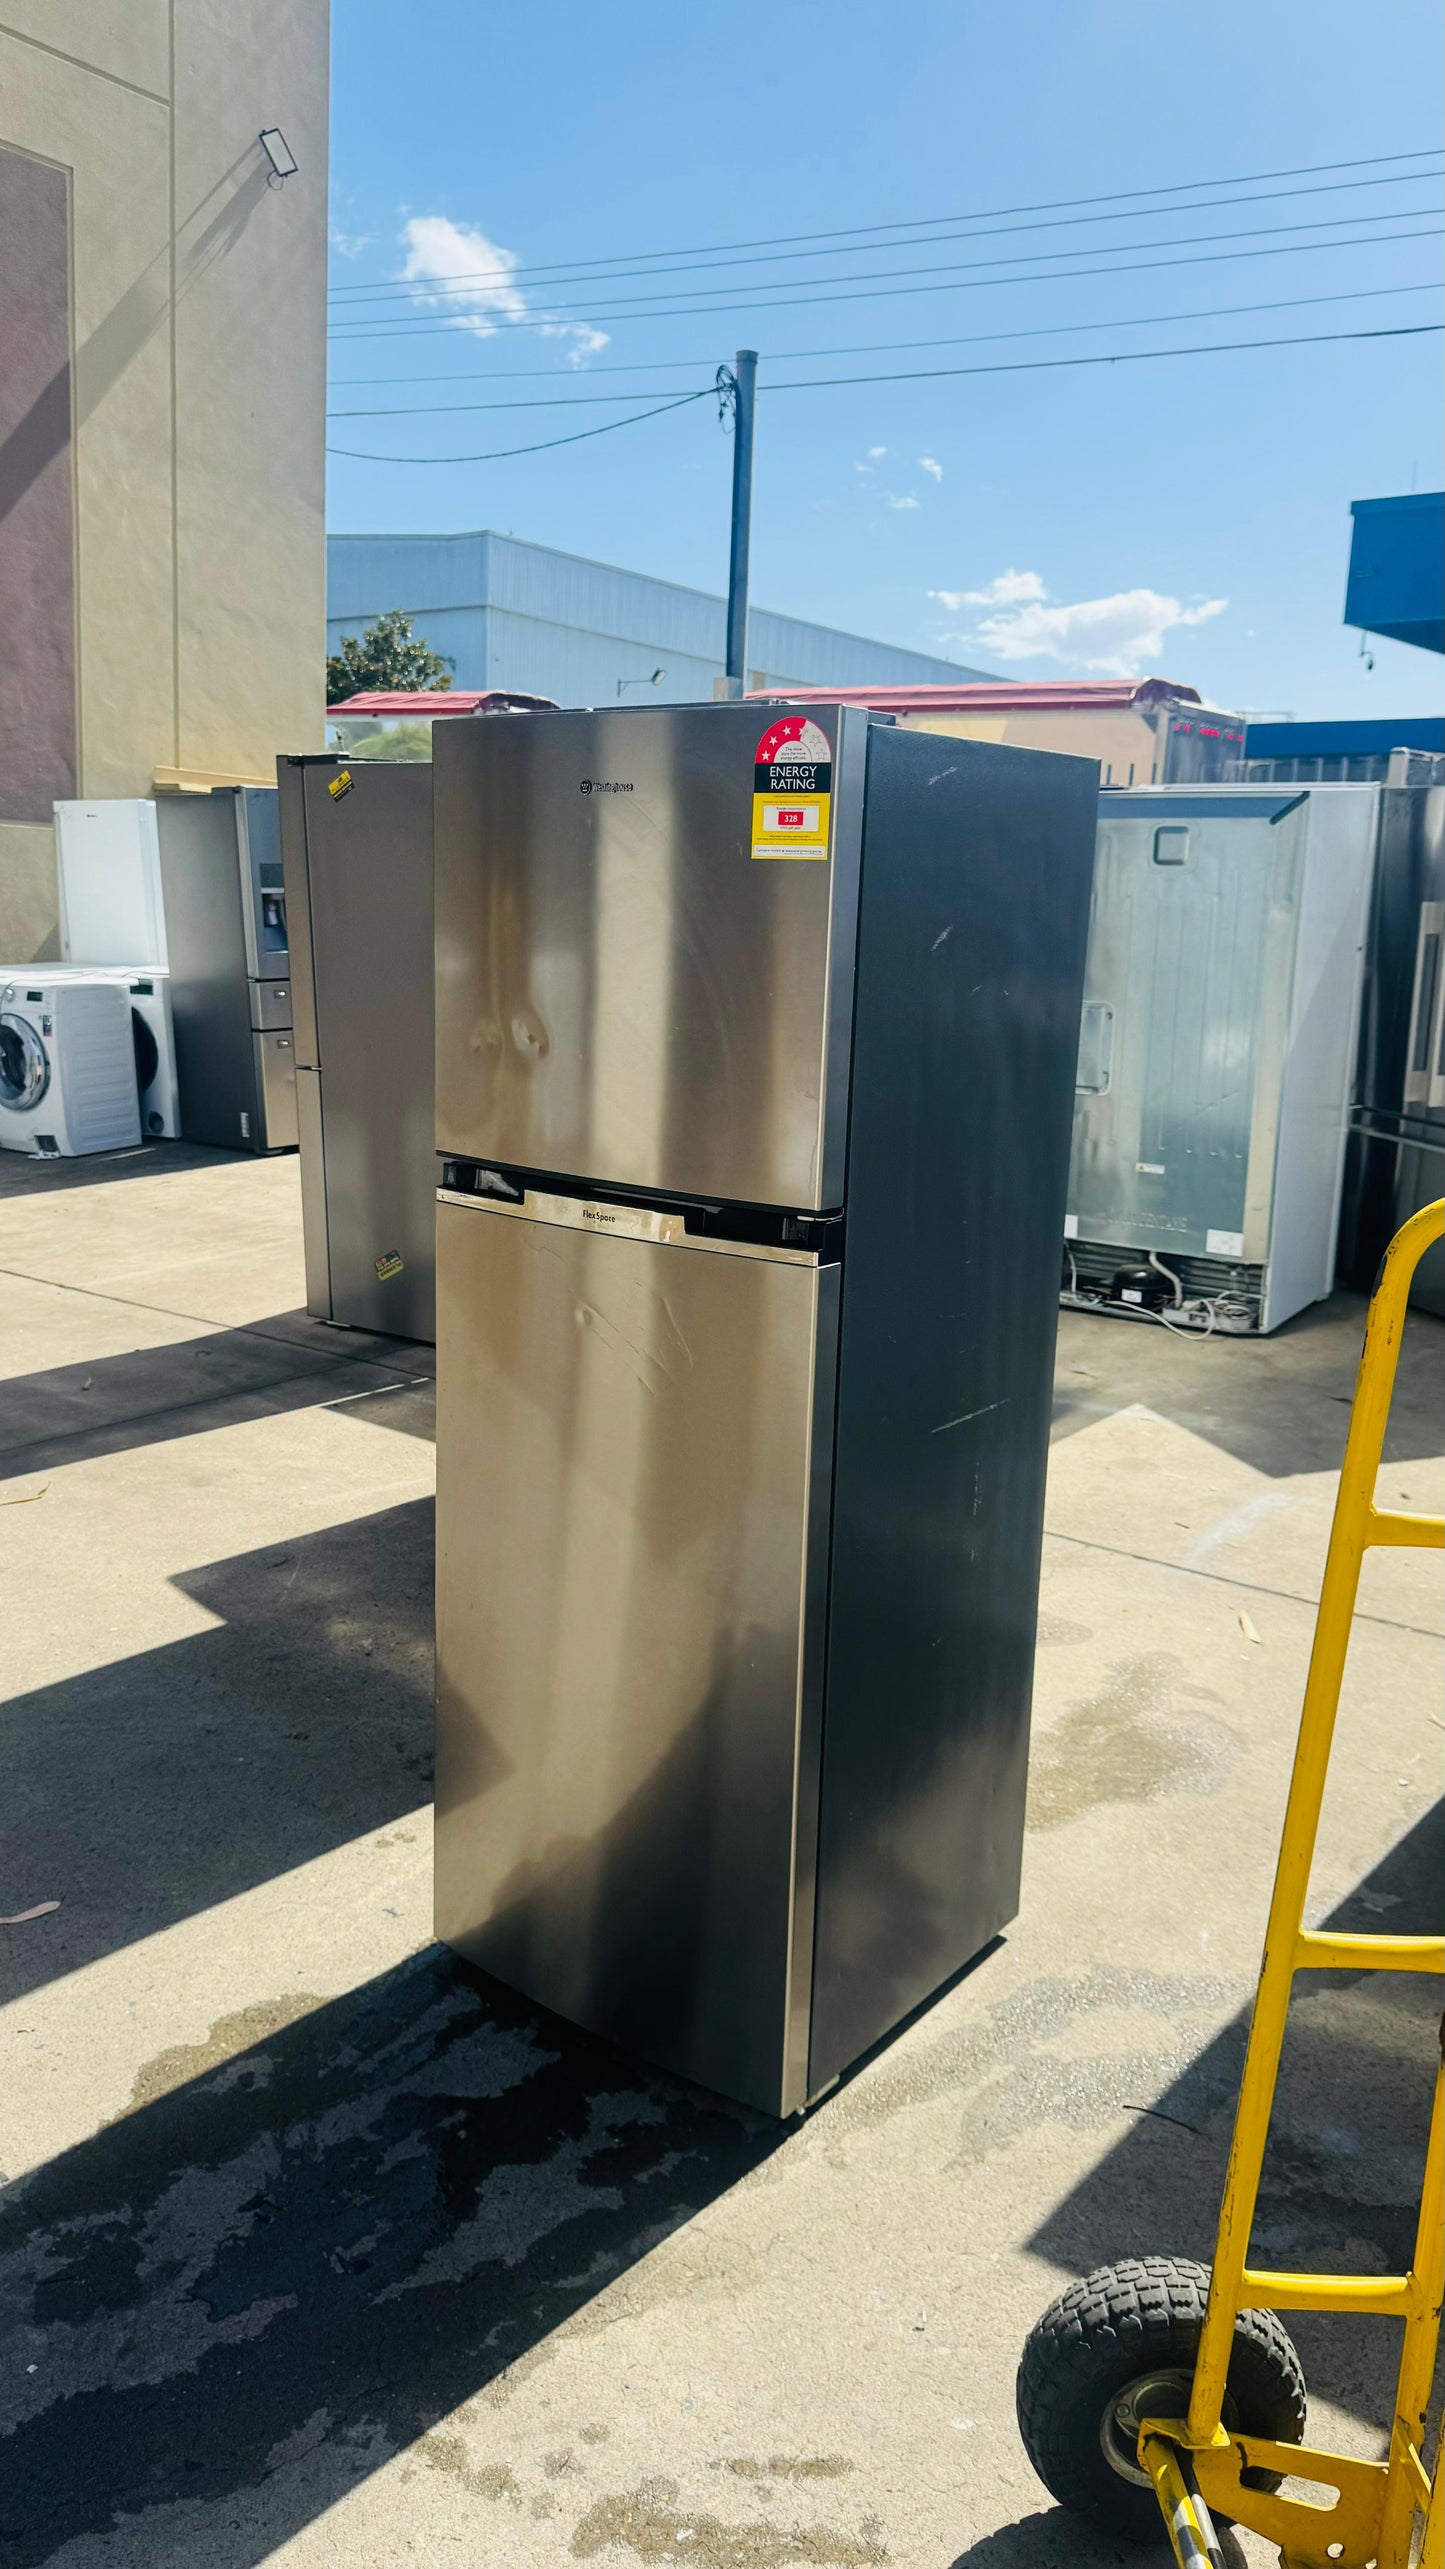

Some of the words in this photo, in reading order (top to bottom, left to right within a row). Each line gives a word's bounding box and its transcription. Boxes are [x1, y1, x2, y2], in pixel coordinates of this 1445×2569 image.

[769, 766, 817, 777] ENERGY
[770, 779, 816, 790] RATING
[784, 814, 798, 823] 328
